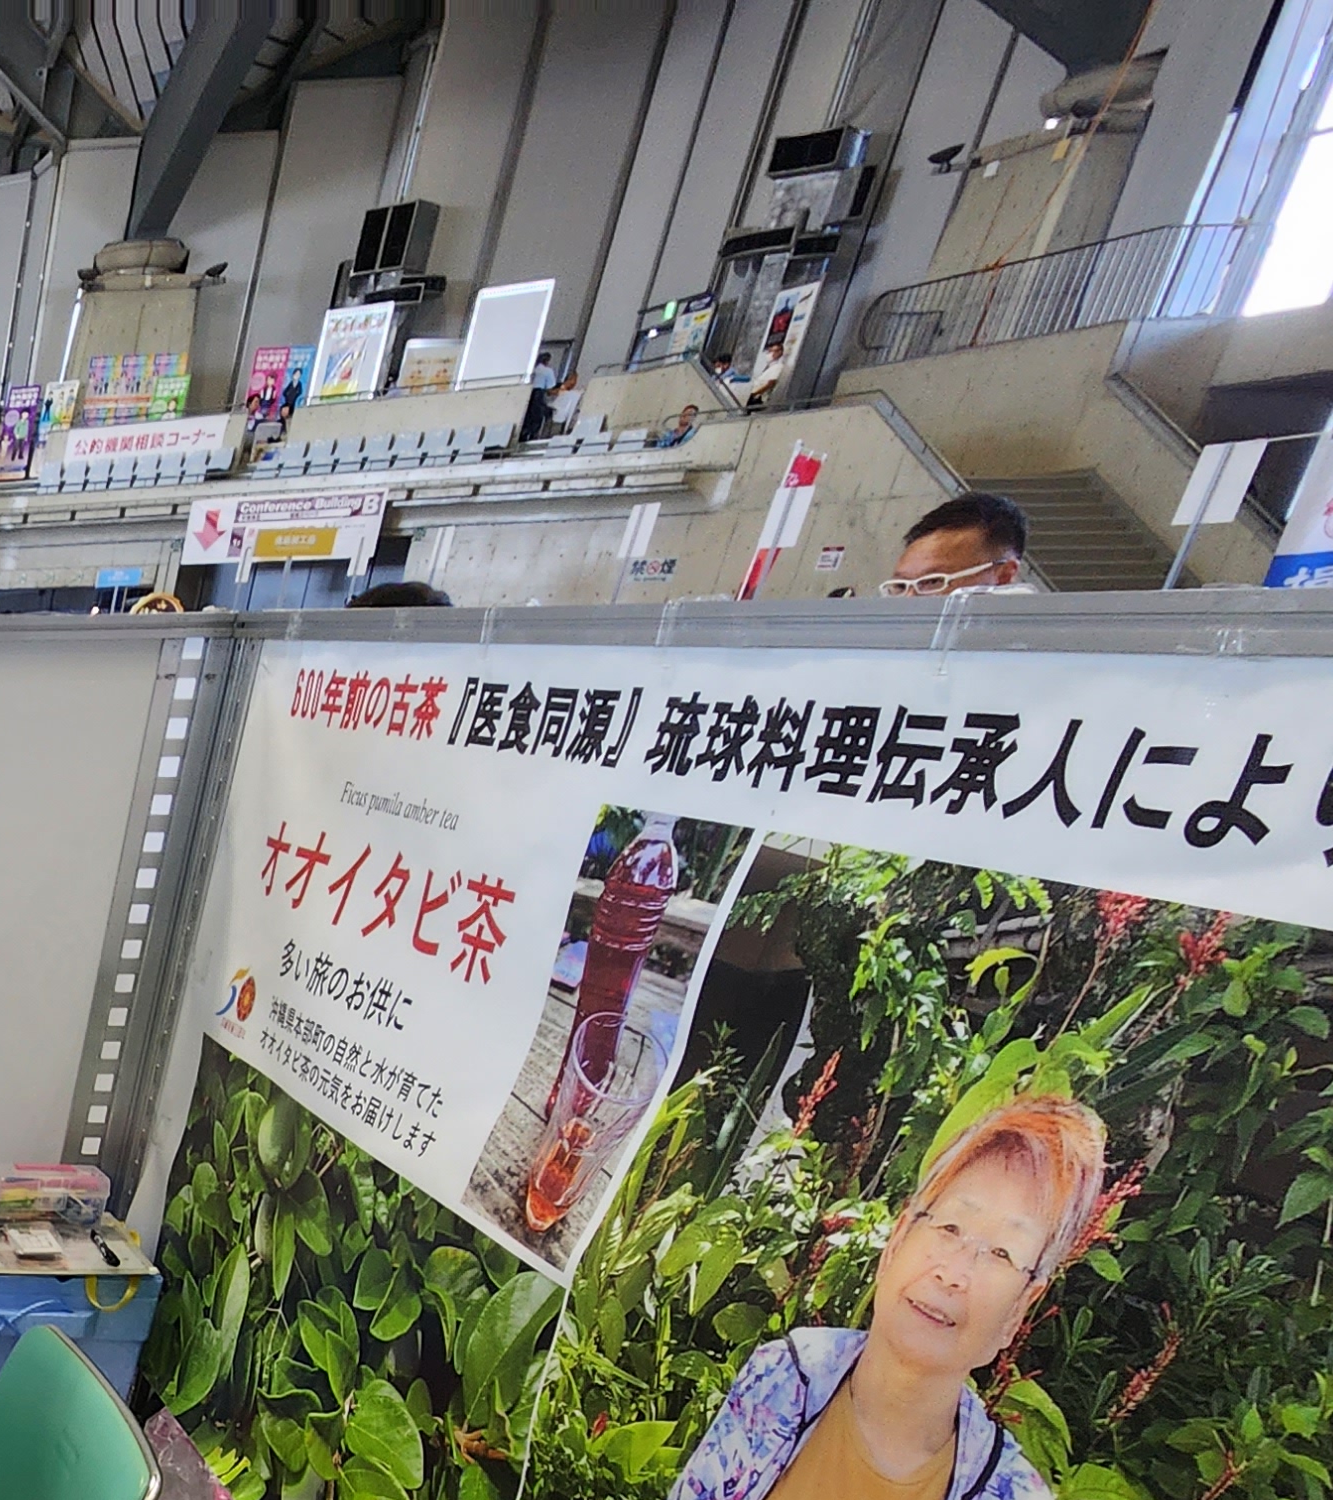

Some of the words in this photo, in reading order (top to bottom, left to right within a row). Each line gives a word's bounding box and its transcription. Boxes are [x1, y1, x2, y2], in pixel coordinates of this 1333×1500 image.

[74, 428, 216, 456] 公的機関相談コーナー
[240, 500, 312, 514] Conference
[314, 495, 362, 510] Building
[290, 668, 450, 742] 600年前の古茶
[340, 780, 369, 808] Ficus
[365, 791, 404, 816] pumila
[403, 797, 440, 826] amber
[438, 808, 460, 831] tea
[261, 820, 517, 985] オオイタビ茶
[279, 938, 414, 1031] 多い旅のお供に
[259, 1028, 437, 1158] オオイタビ茶の元気をお届けします
[267, 995, 445, 1120] 沖縄県本部町の自然と水が育てた
